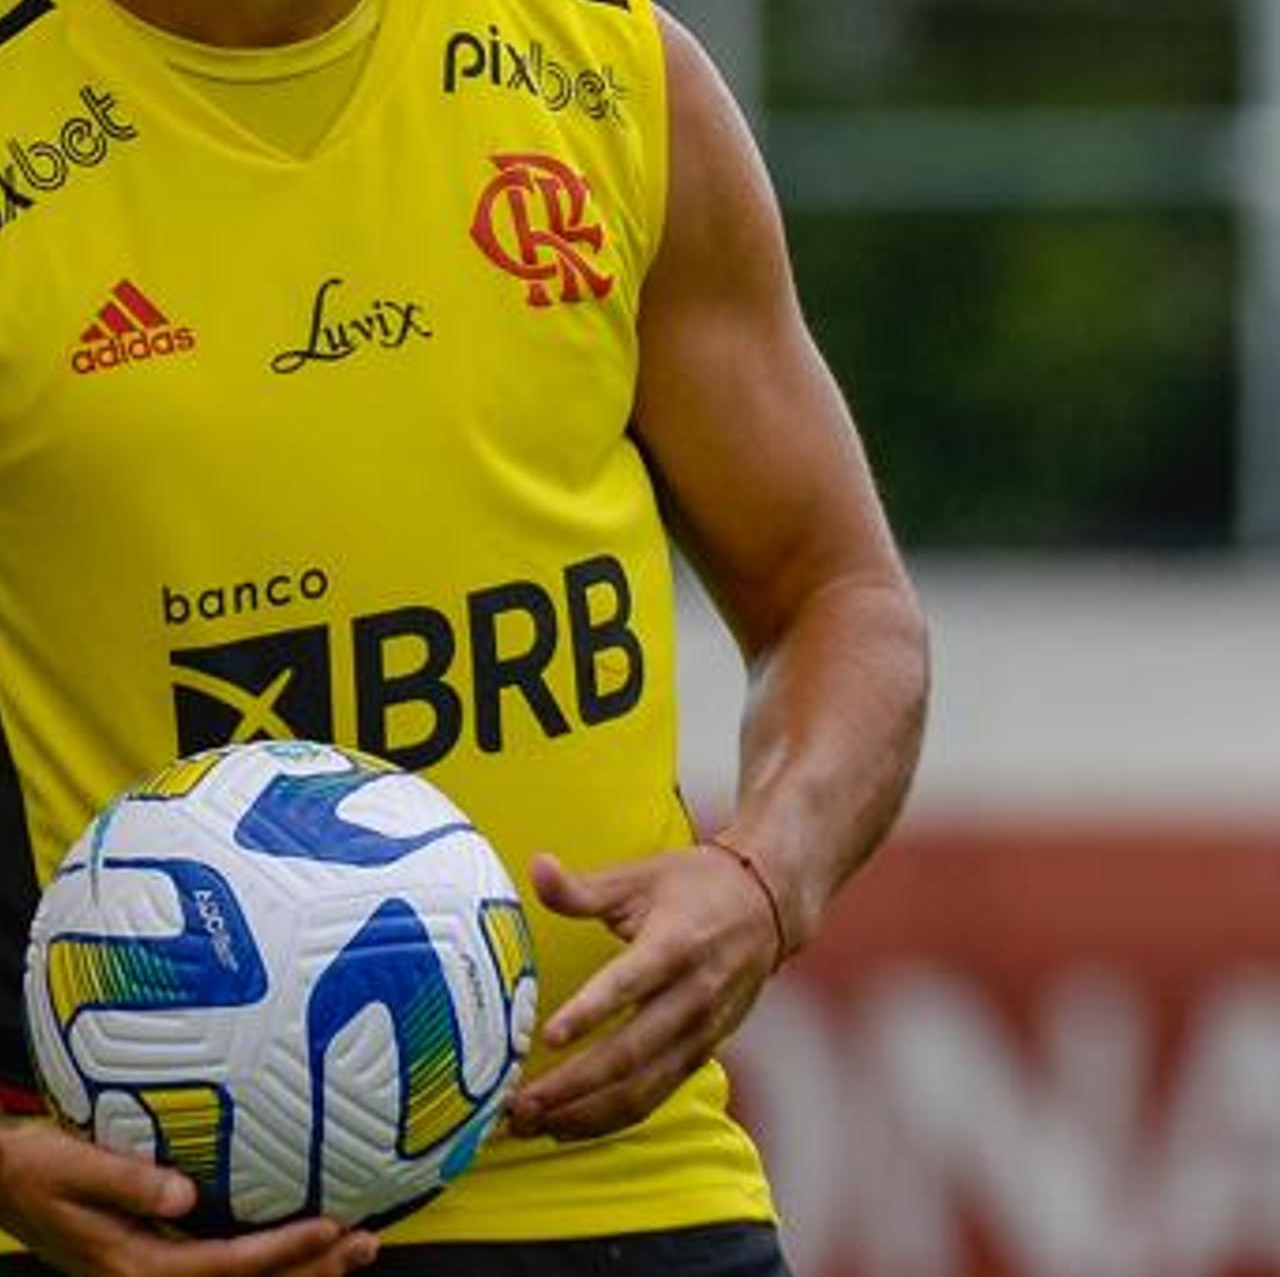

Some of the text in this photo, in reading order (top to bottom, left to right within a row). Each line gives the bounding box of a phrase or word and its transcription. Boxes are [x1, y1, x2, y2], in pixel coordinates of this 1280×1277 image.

[442, 25, 633, 126] pixbet
[71, 322, 196, 375] adidas
[270, 277, 433, 376] Luvix
[162, 567, 329, 624] banco
[349, 553, 645, 775] BRB
